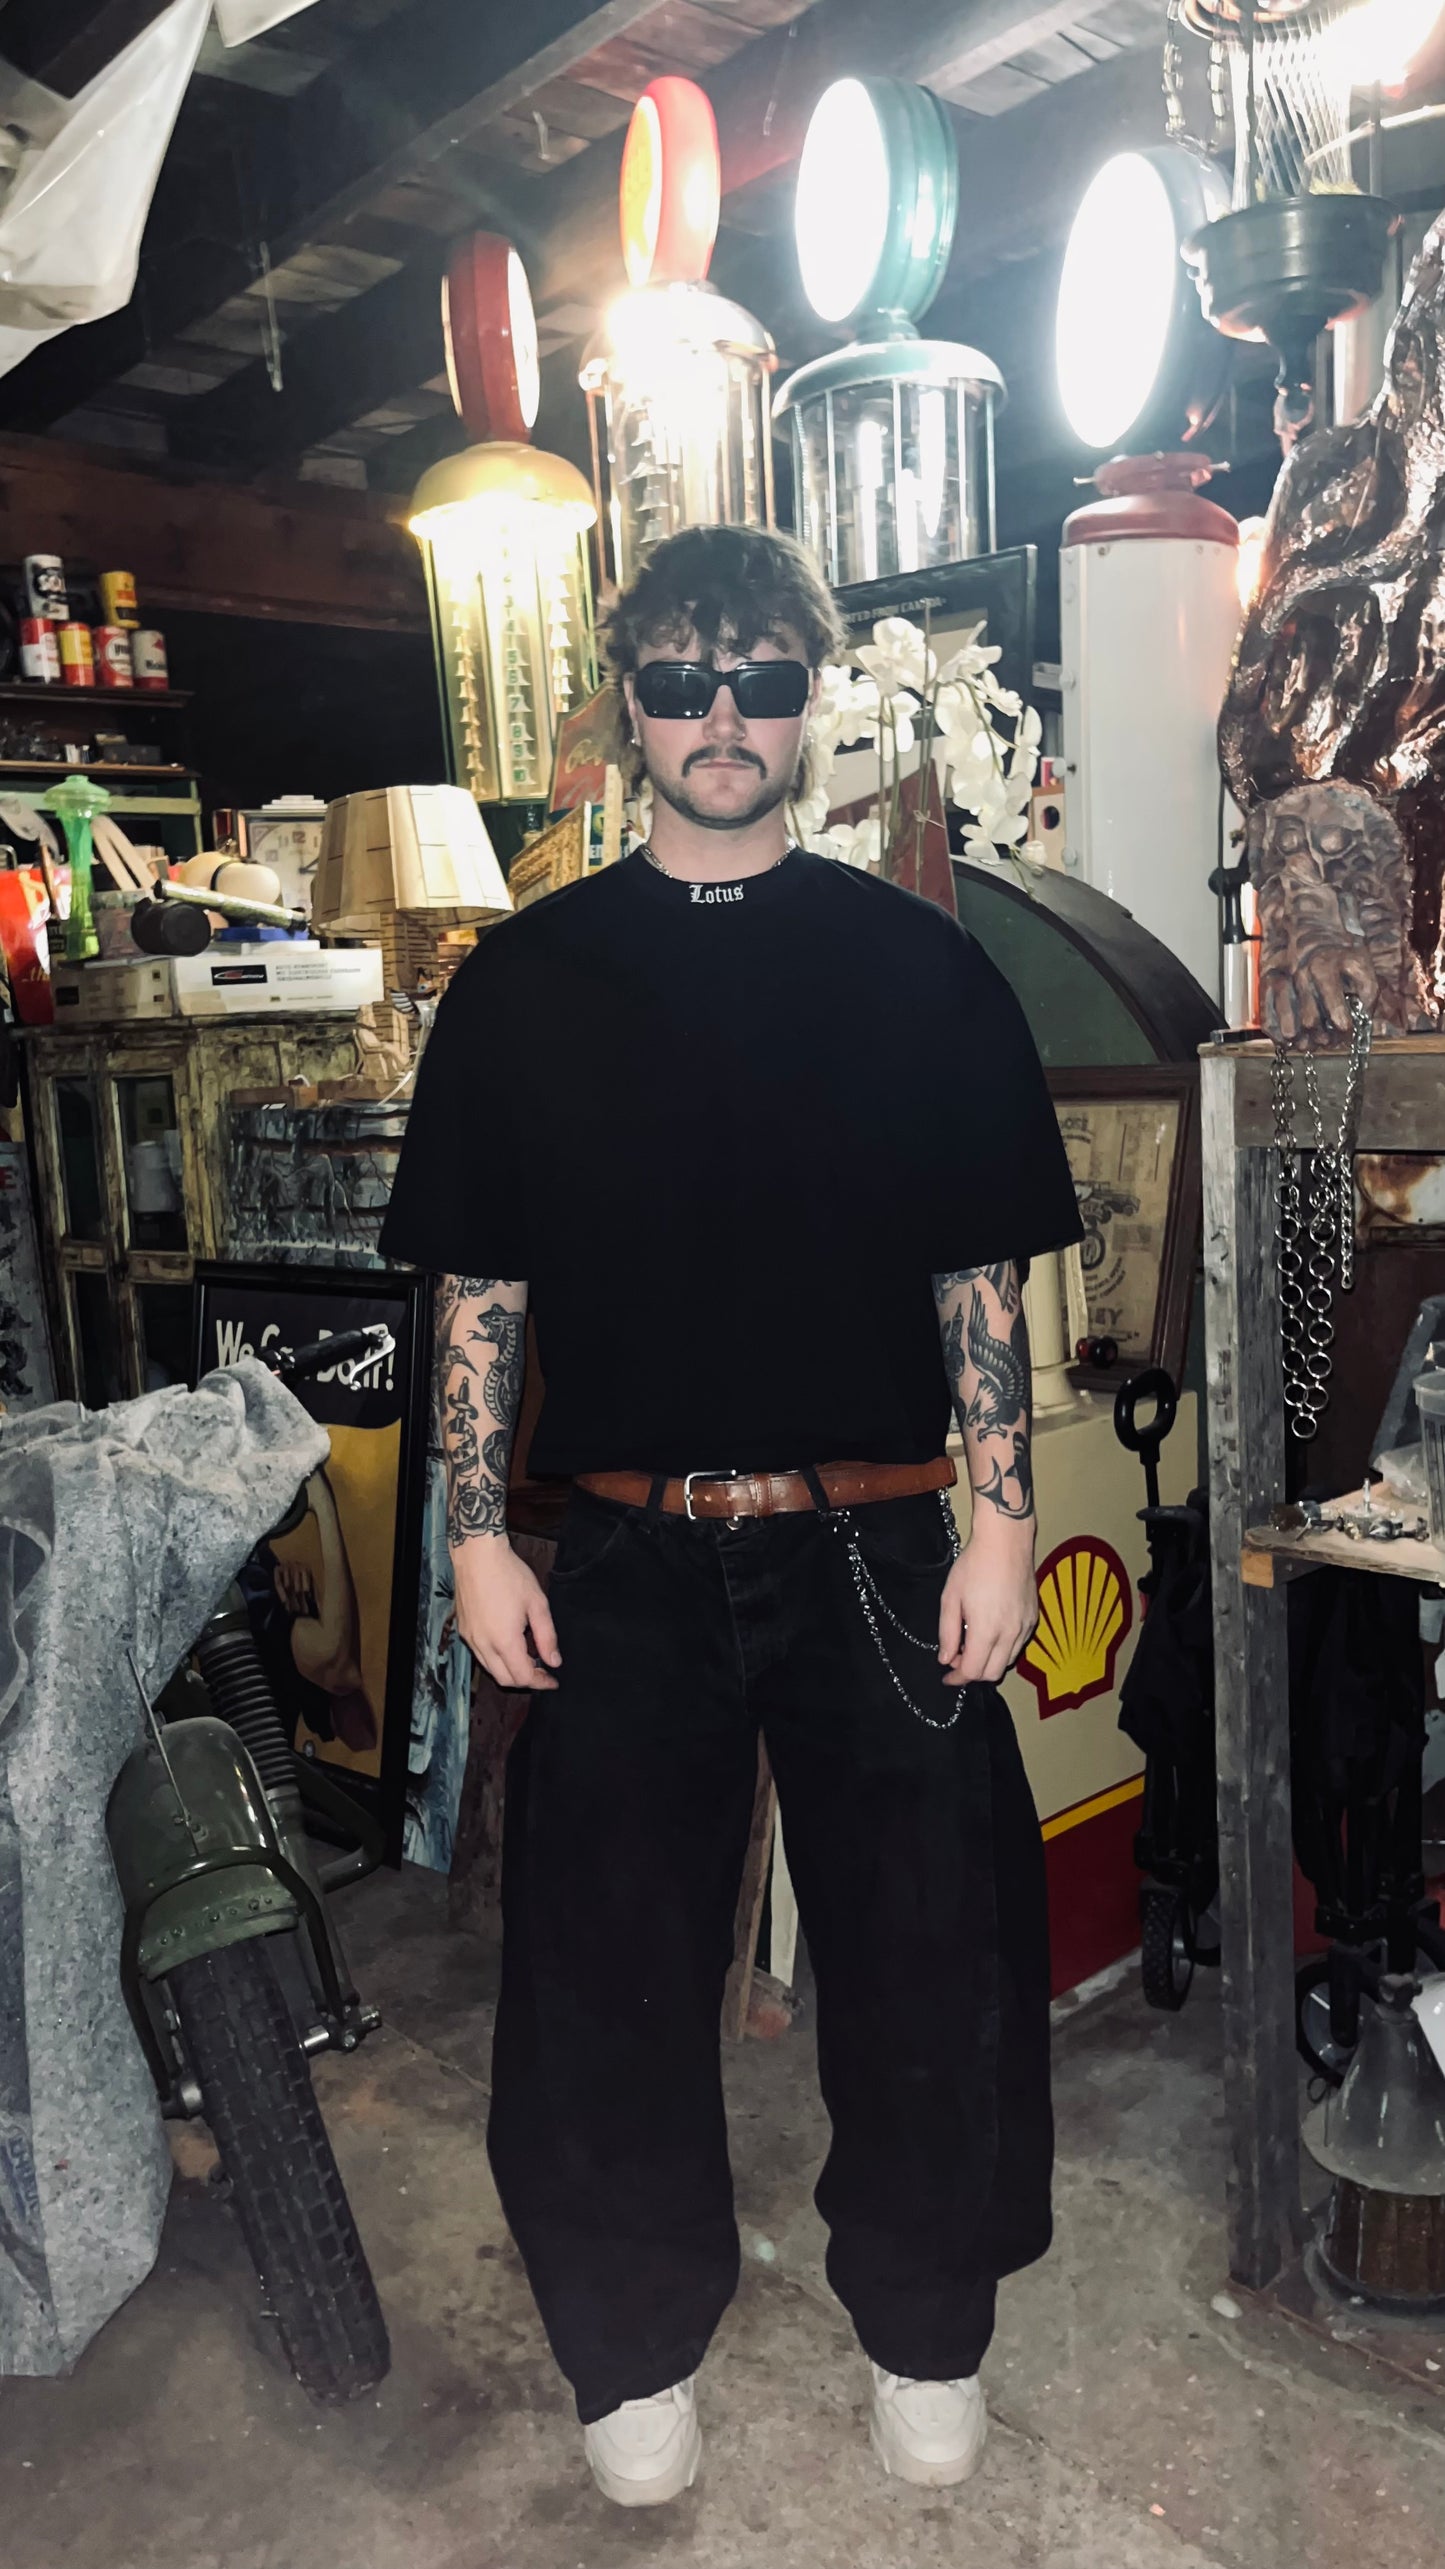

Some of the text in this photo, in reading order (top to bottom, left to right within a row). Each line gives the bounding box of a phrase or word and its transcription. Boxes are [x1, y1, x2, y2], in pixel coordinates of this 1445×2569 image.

[510, 697, 520, 709] 7
[513, 725, 522, 738] 8
[689, 884, 744, 904] Lotus
